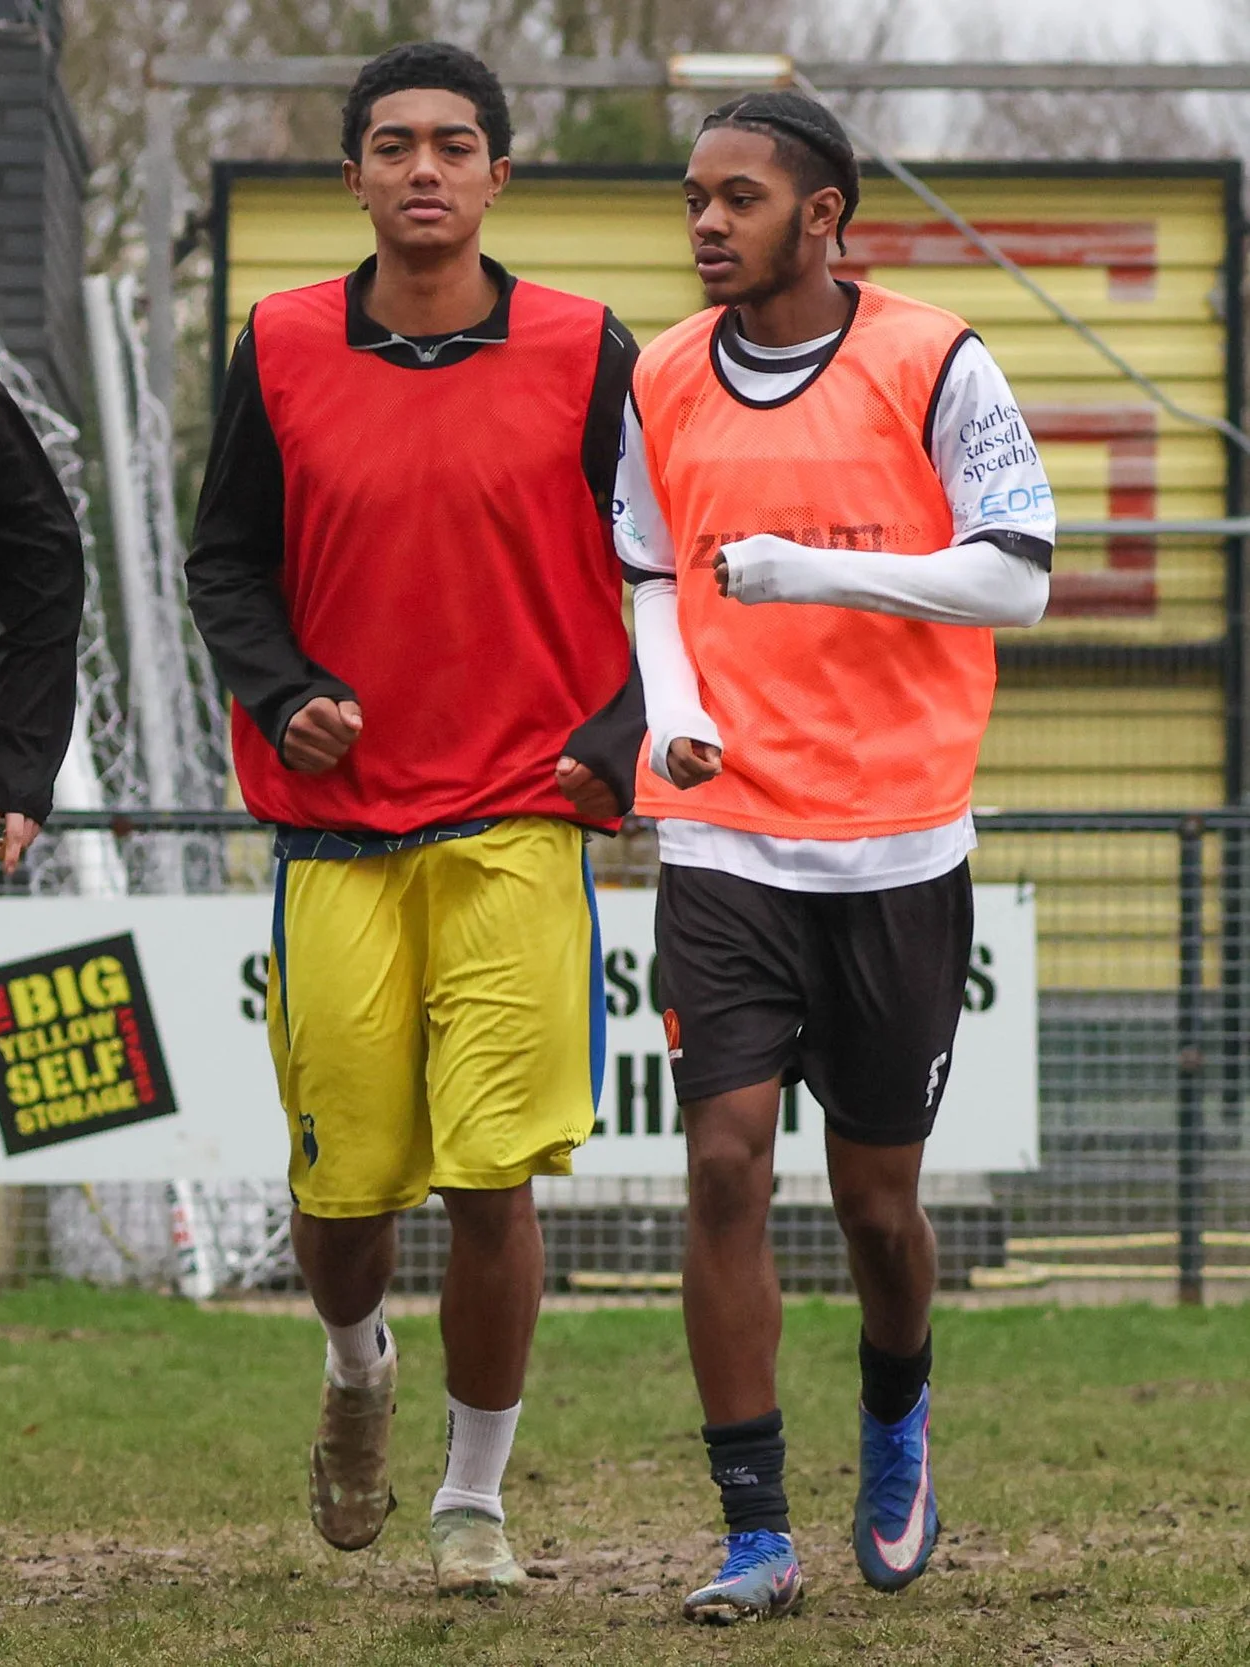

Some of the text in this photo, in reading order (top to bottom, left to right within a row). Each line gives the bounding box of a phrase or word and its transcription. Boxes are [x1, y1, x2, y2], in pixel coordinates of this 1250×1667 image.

[959, 403, 1019, 443] Charles
[8, 955, 132, 1029] BIG
[5, 1037, 126, 1106] SELF
[14, 1079, 138, 1136] STORAGE
